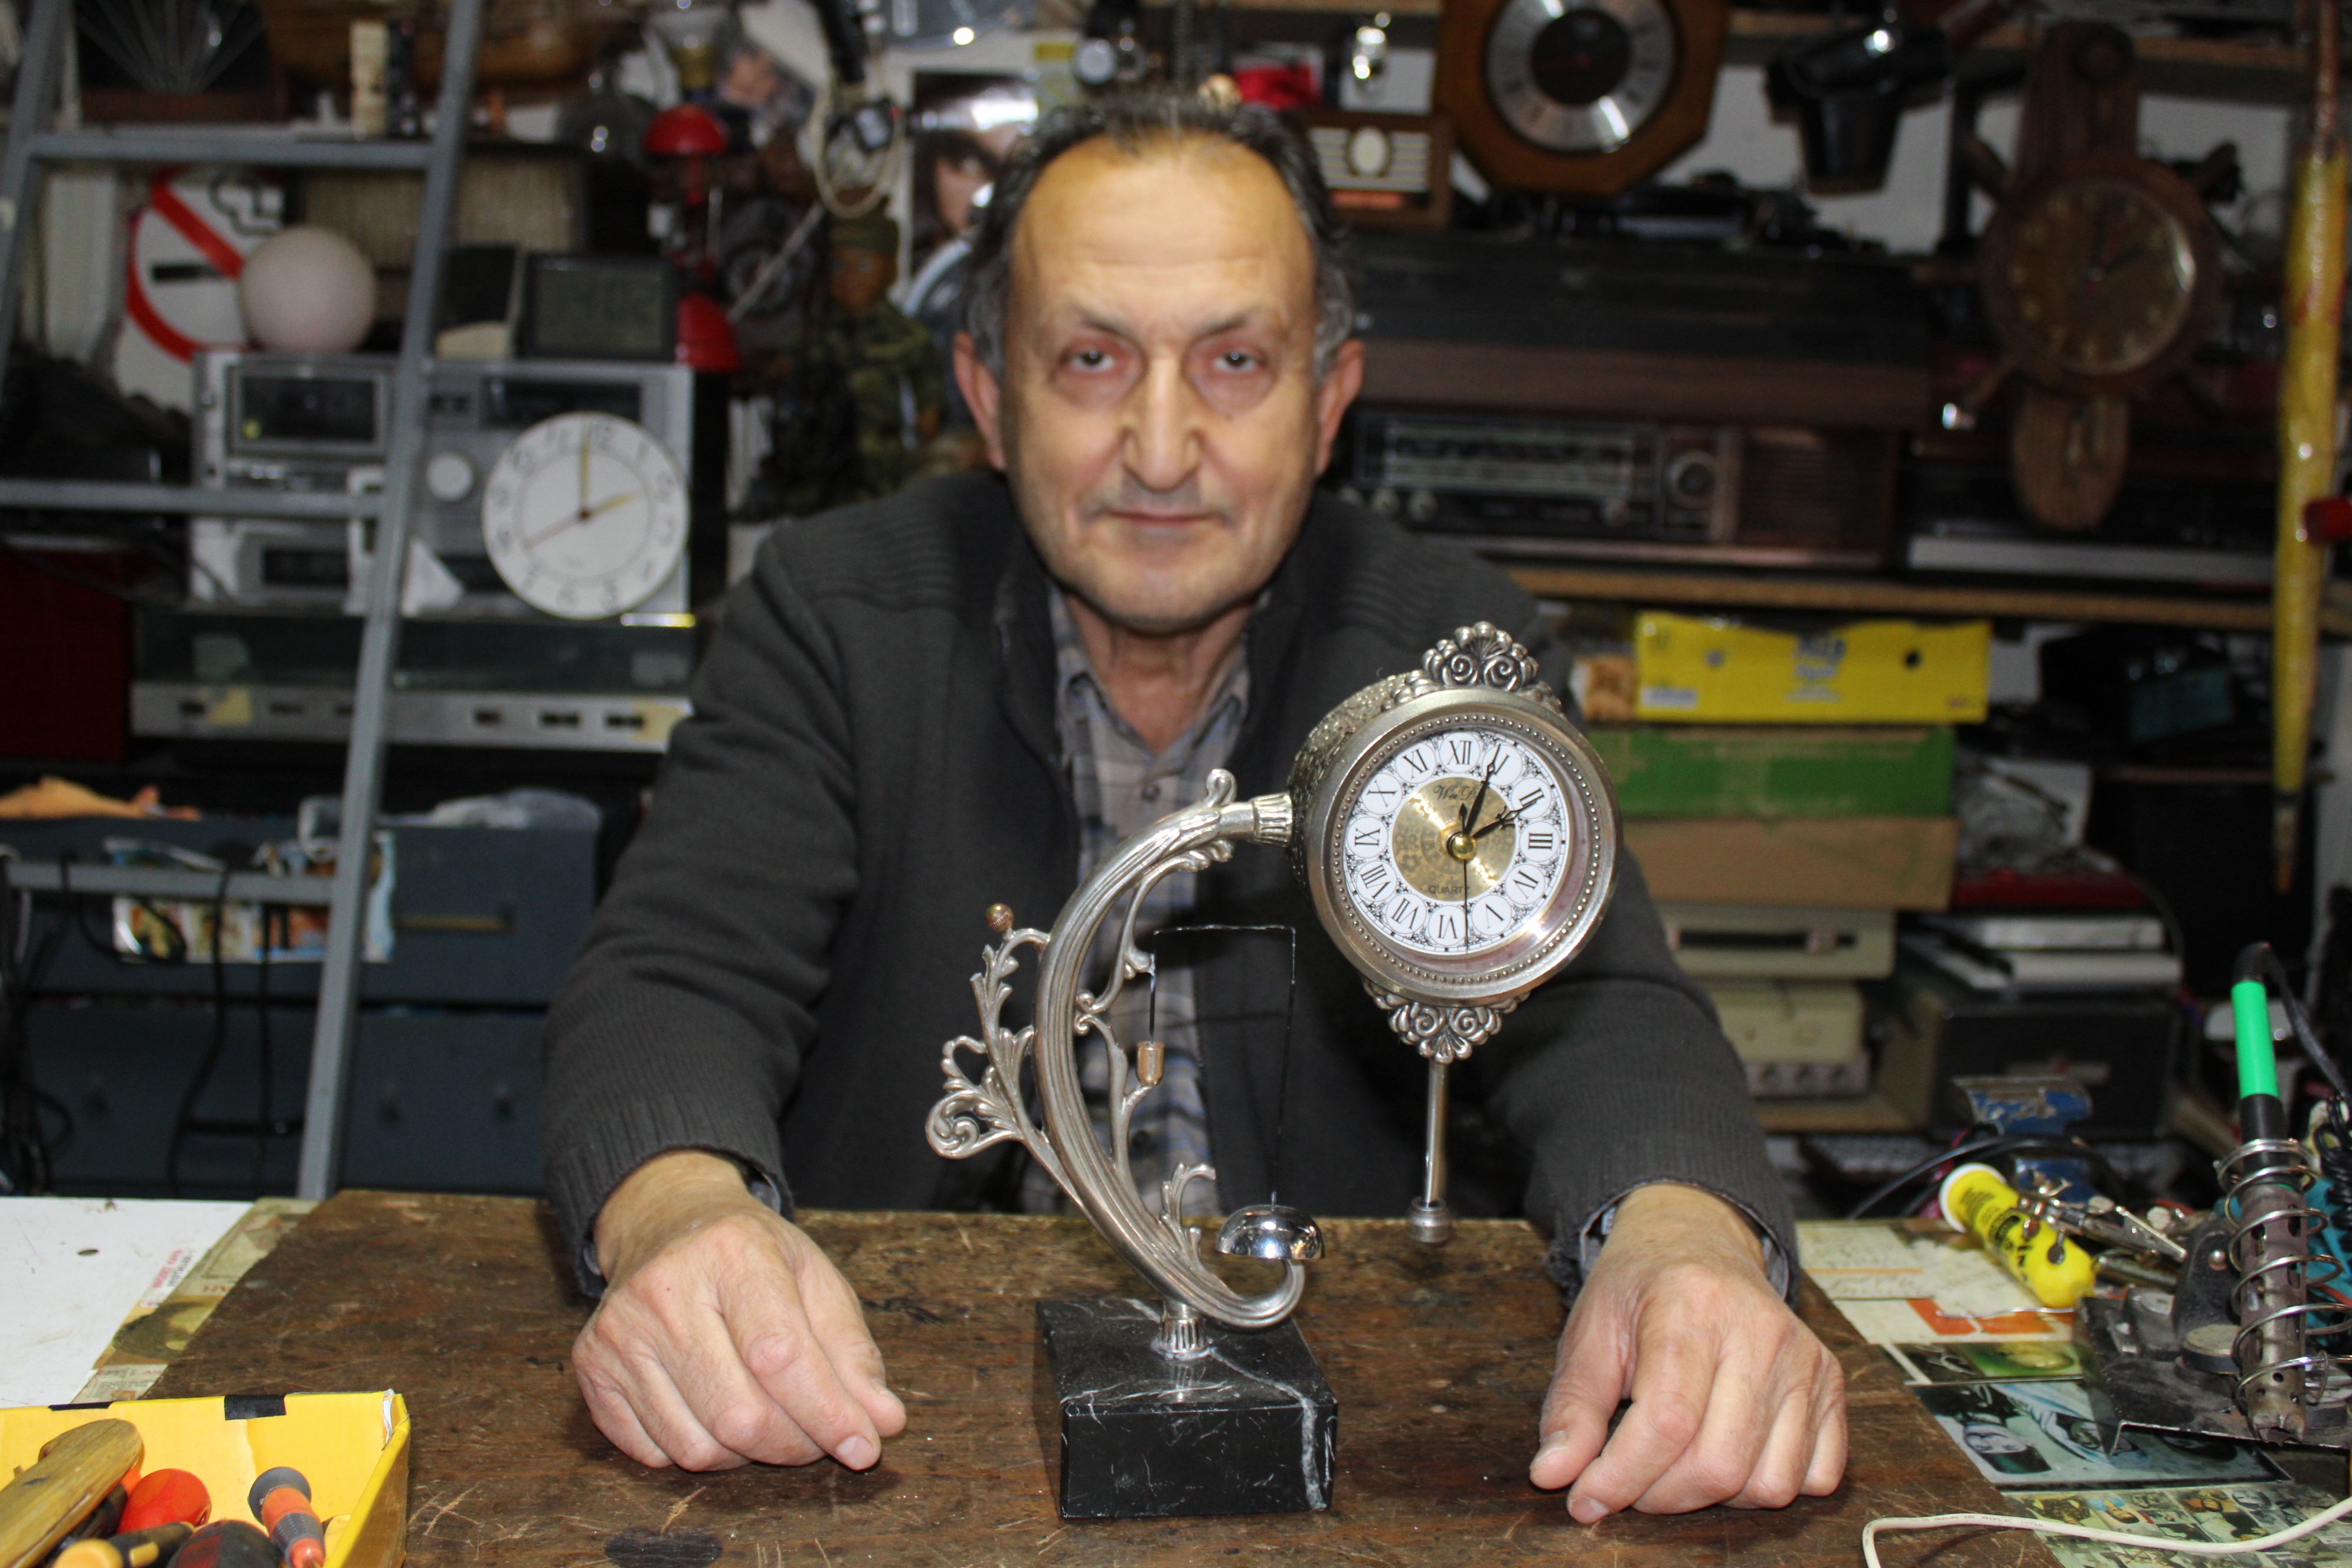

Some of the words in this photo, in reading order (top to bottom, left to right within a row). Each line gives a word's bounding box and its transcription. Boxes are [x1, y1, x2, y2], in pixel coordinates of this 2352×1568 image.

[1402, 748, 1429, 779] XI
[1446, 740, 1472, 765] XII
[1366, 780, 1398, 809] X
[1518, 788, 1546, 808] II
[1354, 828, 1381, 847] IX
[1528, 832, 1553, 850] III
[1360, 863, 1391, 900] VIII
[1428, 885, 1471, 895] QUARTZ
[1513, 870, 1540, 900] IV
[1390, 897, 1420, 931] VII
[1437, 914, 1458, 939] VI
[1485, 903, 1505, 929] V
